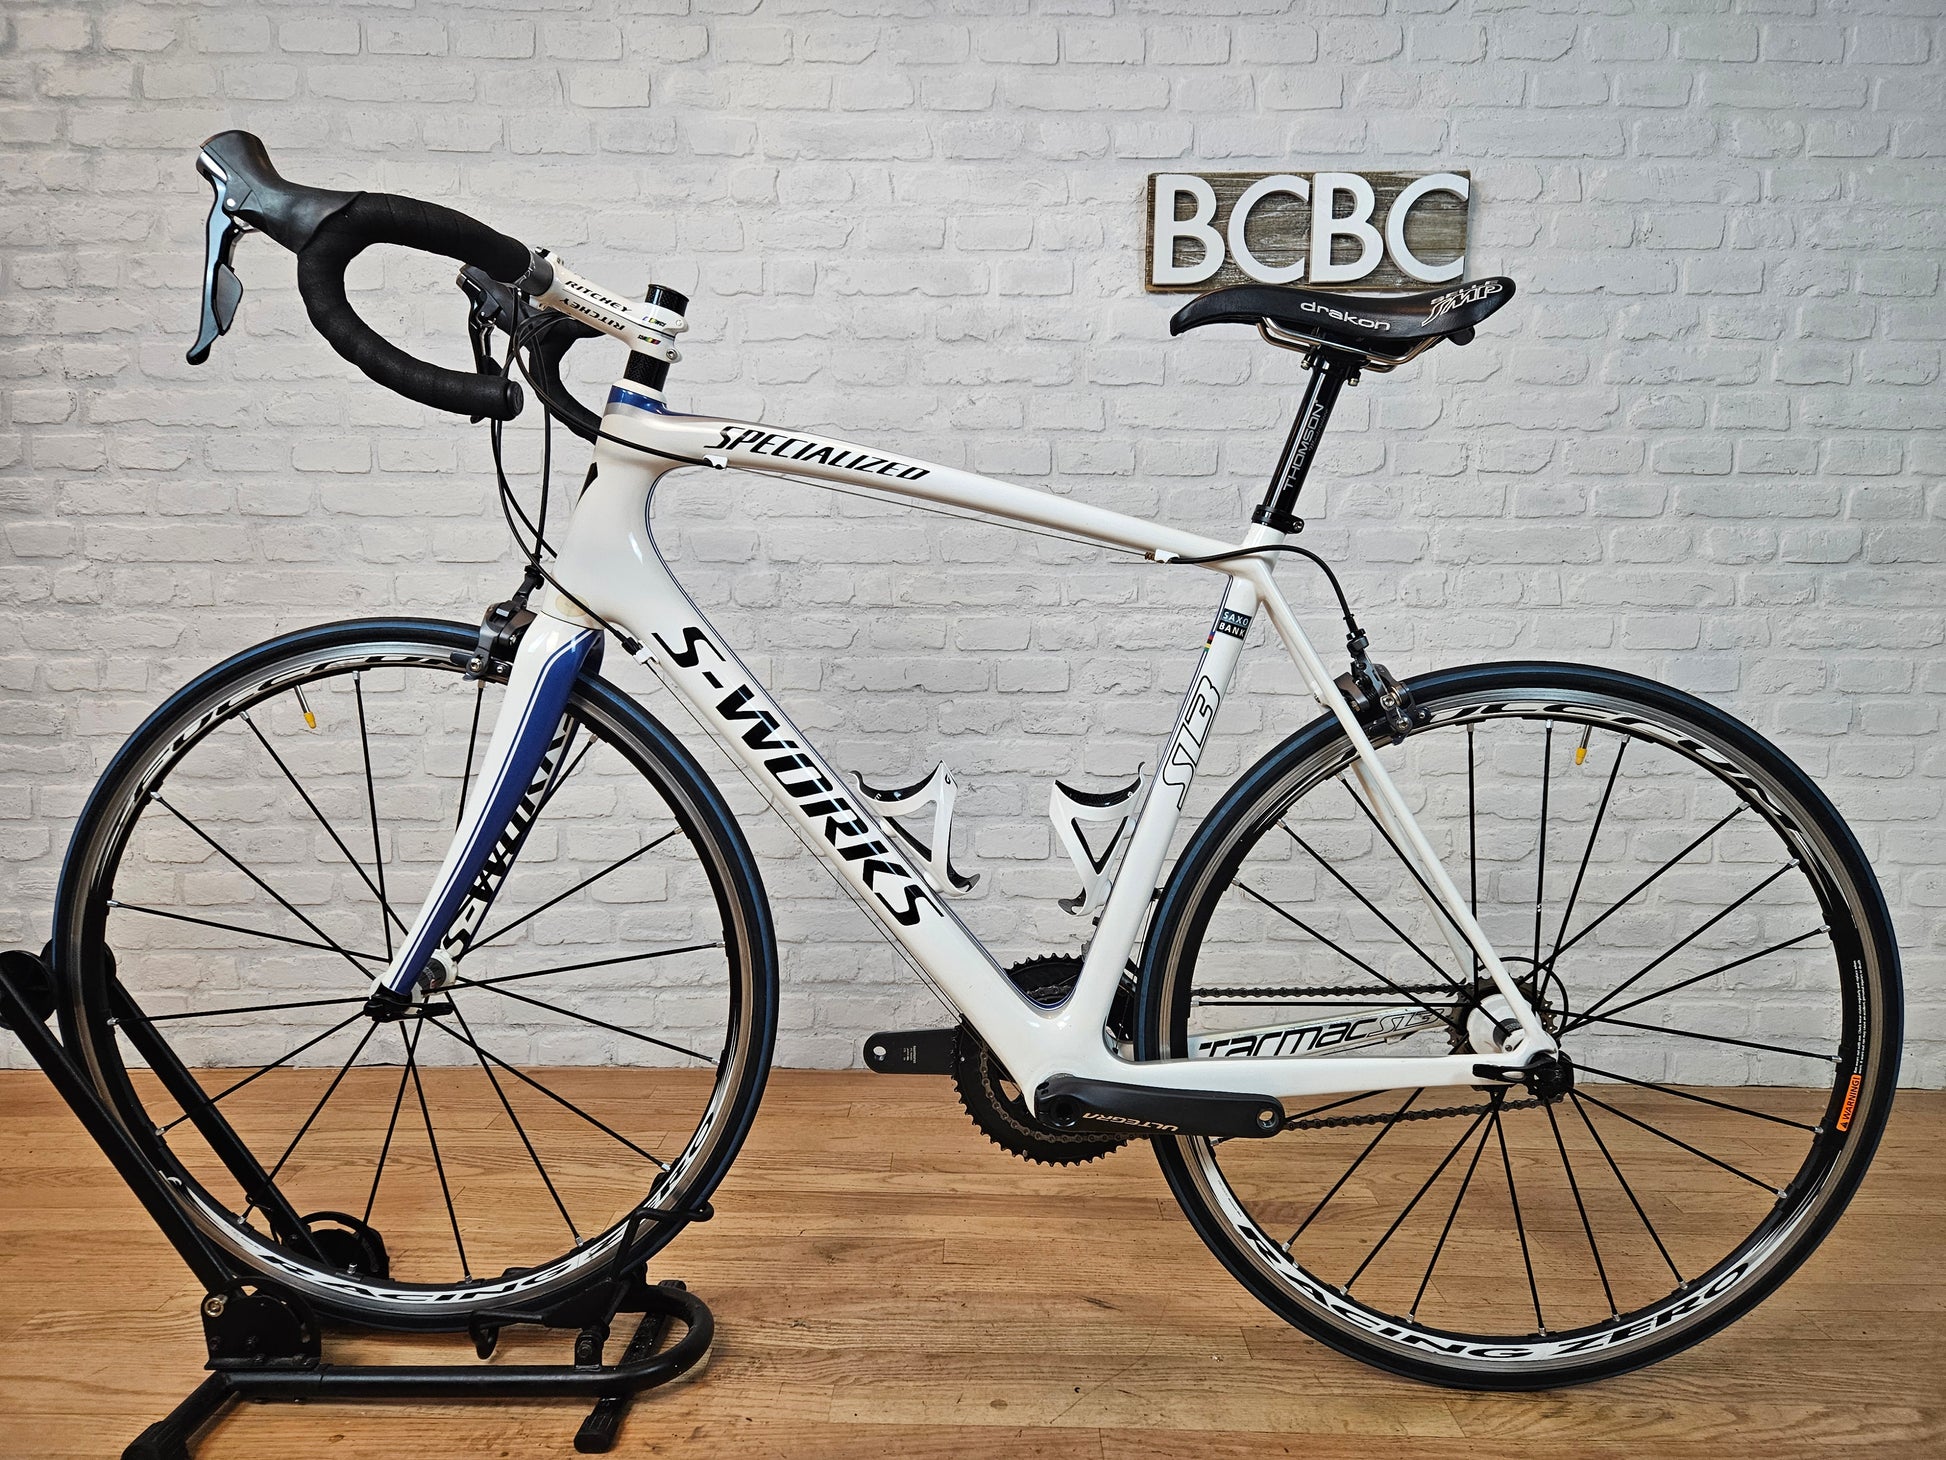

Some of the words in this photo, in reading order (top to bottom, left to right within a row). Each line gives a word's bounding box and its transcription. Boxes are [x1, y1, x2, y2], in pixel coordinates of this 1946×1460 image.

[1152, 173, 1469, 285] BCBC
[562, 297, 626, 332] RITCHEY
[565, 280, 633, 314] RITCHEY
[1300, 300, 1391, 332] drakon
[703, 425, 931, 481] SPECIALIZED
[1283, 402, 1325, 491] THOMSON
[1218, 621, 1247, 638] BANK
[1222, 611, 1249, 627] SAXO
[651, 626, 945, 926] S-WORKS
[1340, 700, 1804, 834] ULCRUM
[1082, 1111, 1180, 1132] ULTEGRA
[1842, 1076, 1861, 1121] WARNING!
[257, 1254, 577, 1303] RACING
[1238, 1223, 1535, 1359] RACING
[1558, 1262, 1749, 1352] ZERO
